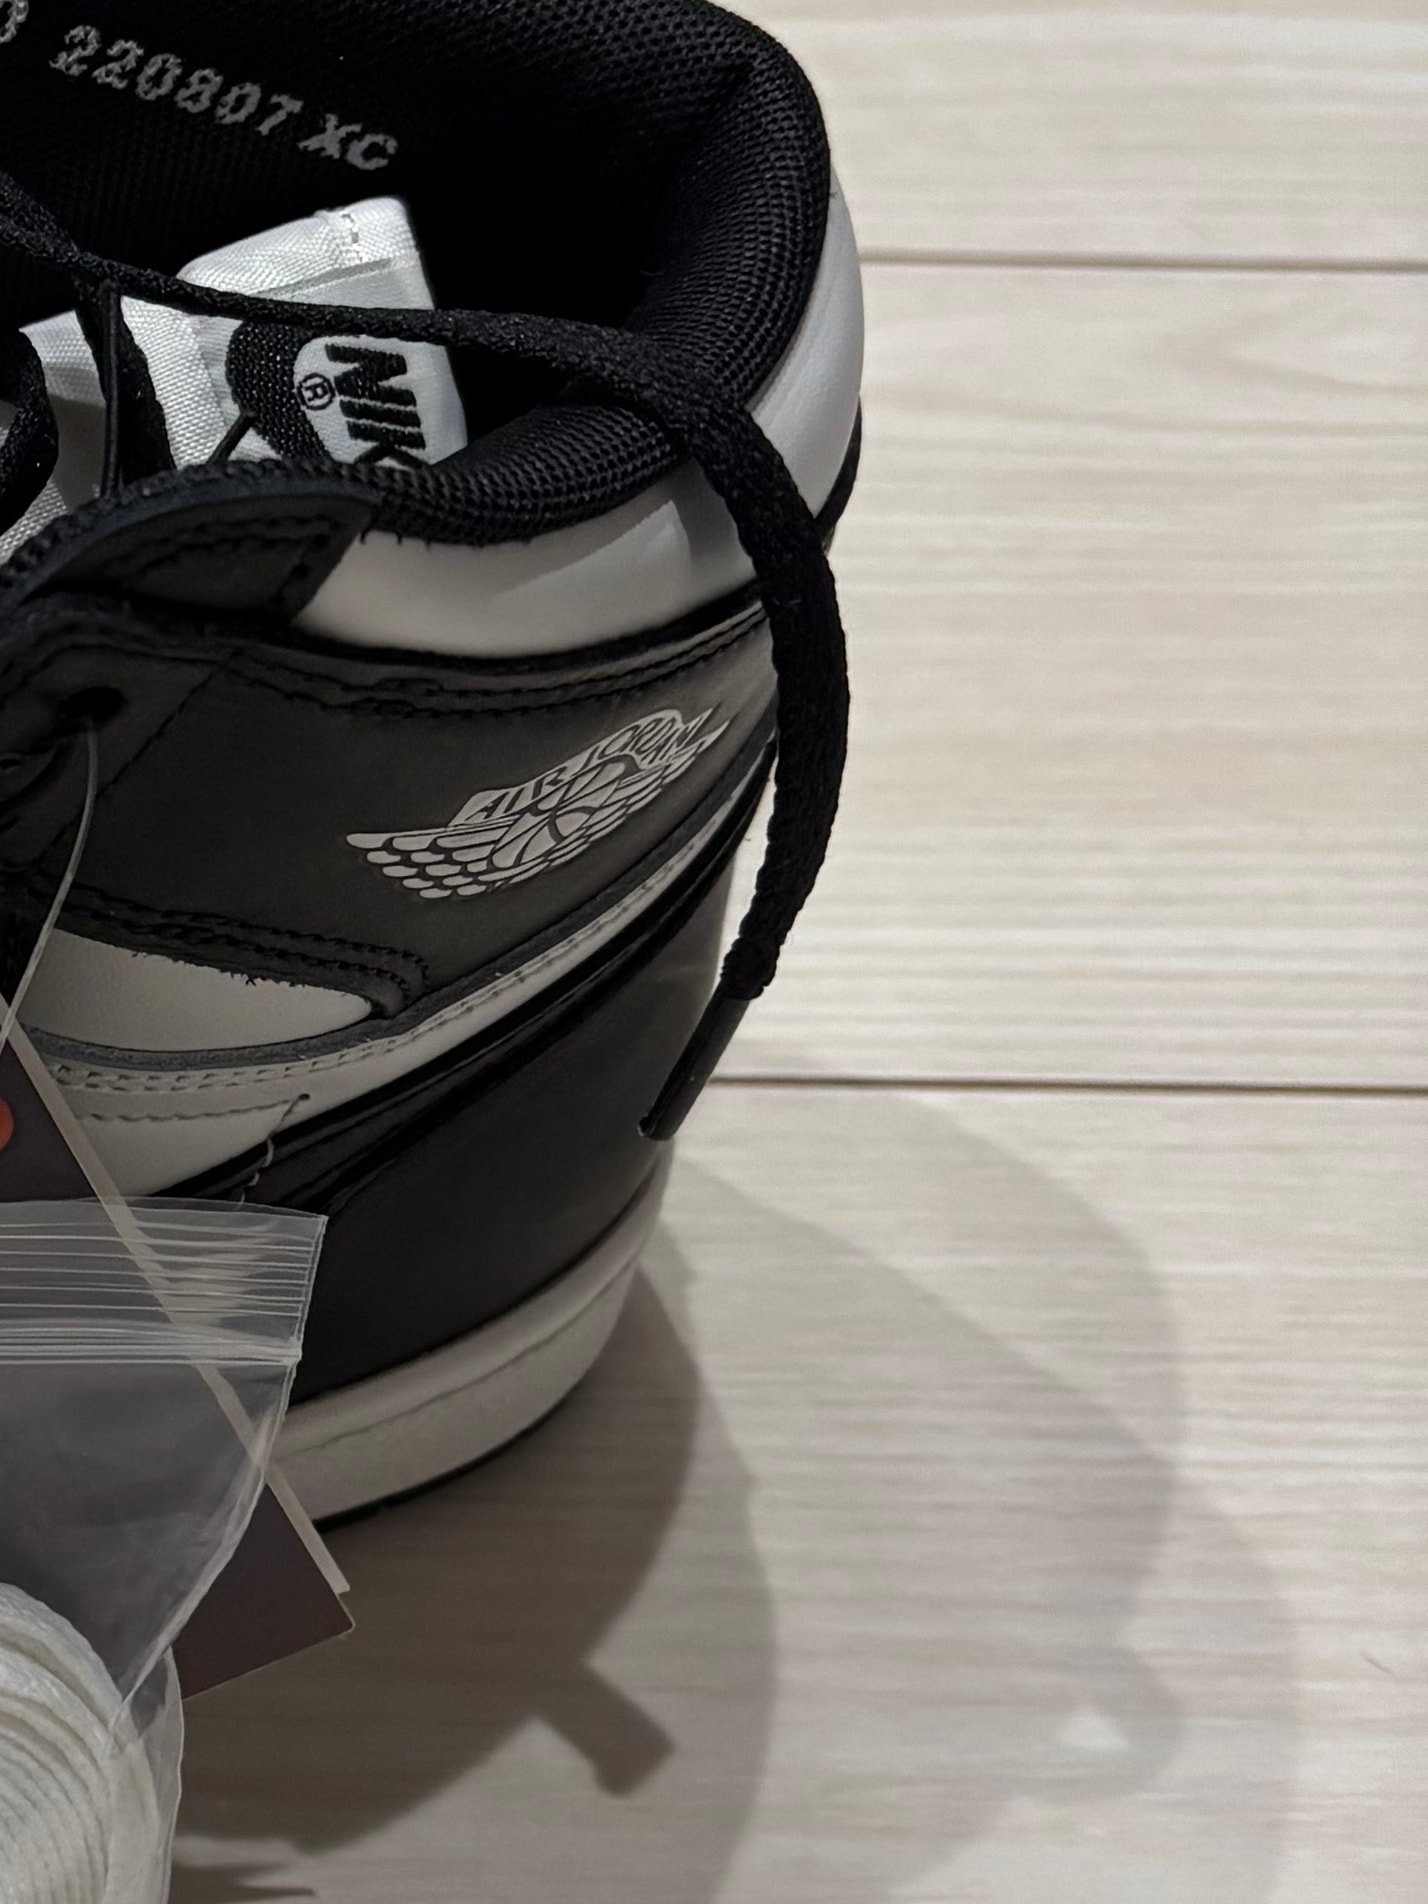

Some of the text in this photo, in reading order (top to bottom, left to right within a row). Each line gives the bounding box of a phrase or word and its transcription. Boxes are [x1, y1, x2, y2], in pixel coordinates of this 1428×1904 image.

[49, 25, 304, 136] 220807
[298, 114, 398, 170] XC
[324, 343, 430, 469] NIK
[465, 717, 698, 820] AIR JORDAN
